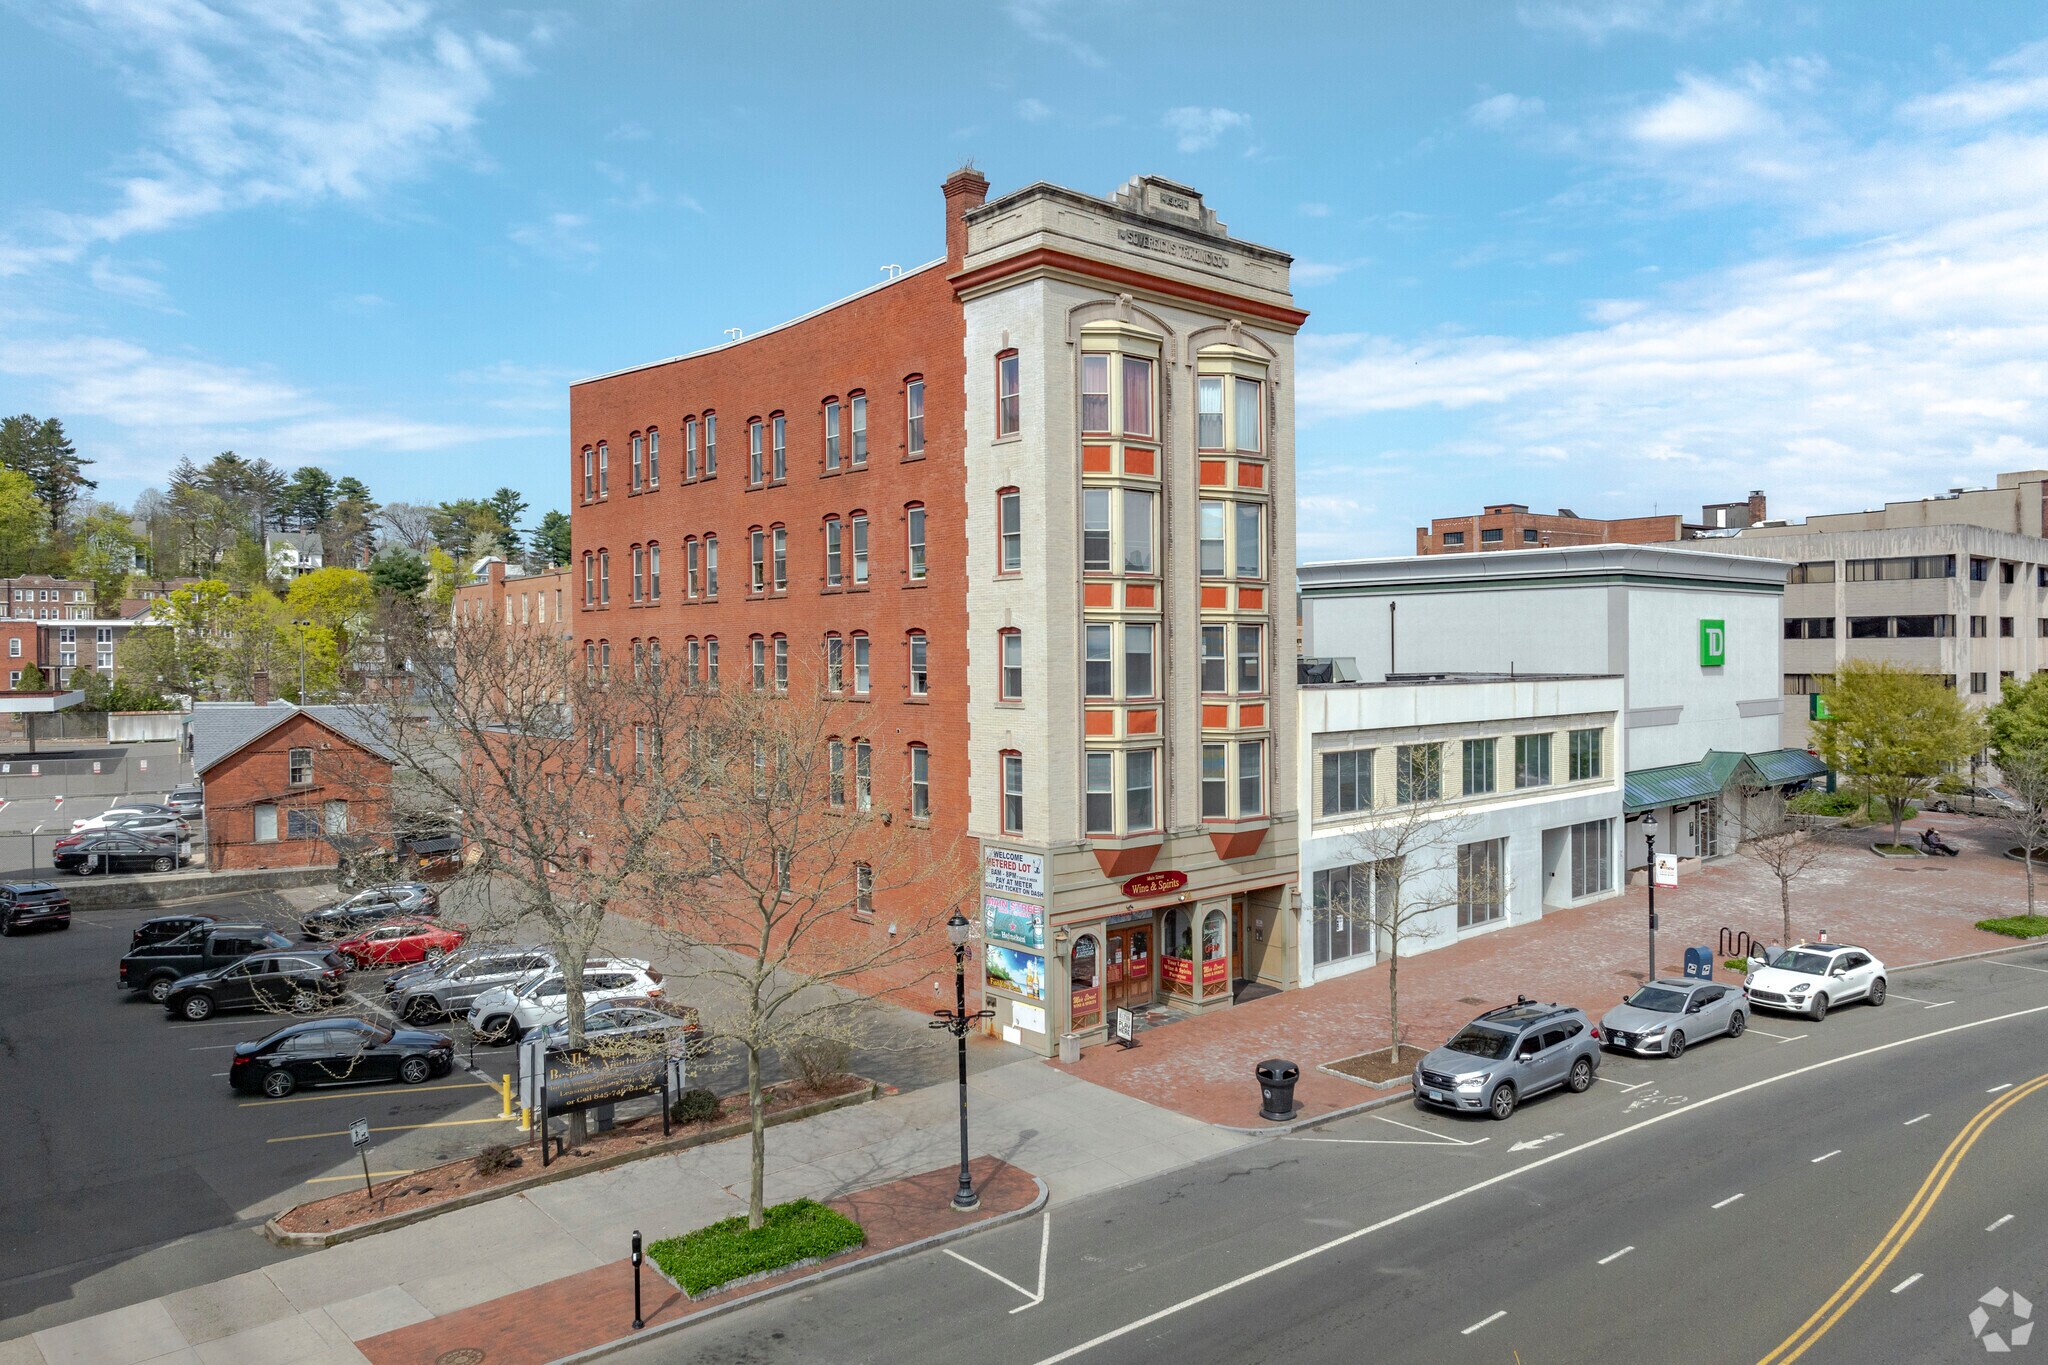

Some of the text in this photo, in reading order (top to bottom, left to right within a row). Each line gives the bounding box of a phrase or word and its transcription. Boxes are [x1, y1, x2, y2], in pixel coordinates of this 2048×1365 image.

[1706, 628, 1723, 656] TD
[993, 851, 1024, 862] WELCOME
[986, 857, 1031, 873] METERED LOT
[1006, 871, 1017, 879] 8PM
[985, 882, 1004, 890] DISPLAY
[1005, 885, 1022, 894] TICKET
[1031, 890, 1044, 898] DASH
[1014, 880, 1033, 889] METER
[1132, 878, 1180, 894] Wine & Spirits
[987, 897, 1044, 915] MAIN STREET
[1001, 931, 1026, 943] Heineken
[1204, 943, 1220, 954] OPEN
[570, 1052, 589, 1067] The
[576, 1095, 592, 1103] Call
